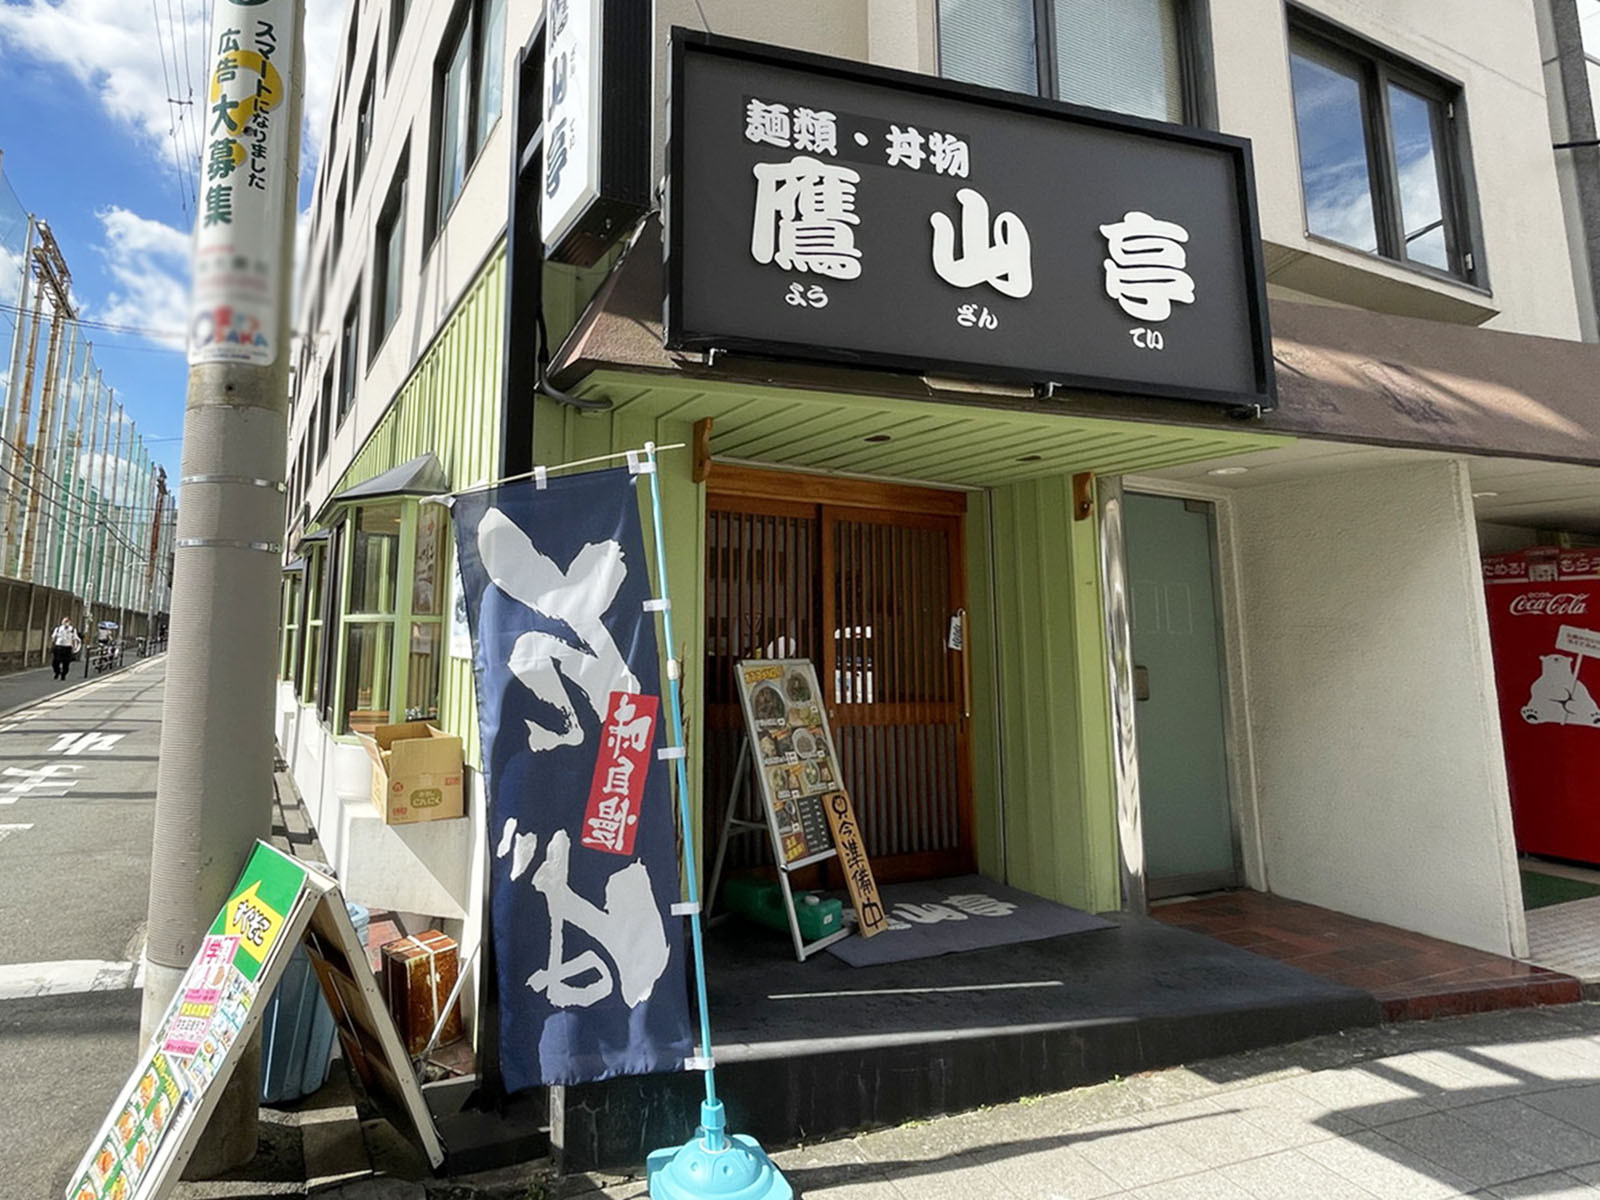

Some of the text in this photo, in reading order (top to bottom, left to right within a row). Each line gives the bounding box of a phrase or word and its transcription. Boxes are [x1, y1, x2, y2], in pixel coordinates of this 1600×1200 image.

[203, 27, 241, 227] 広告大募集
[248, 19, 277, 190] スマートになりました
[744, 98, 969, 178] 麺類・丼物
[751, 156, 1195, 322] 鷹山亭
[785, 283, 1164, 350] よう ざん てい
[1509, 593, 1591, 616] Coca-Cola
[842, 894, 1018, 930] 山亭
